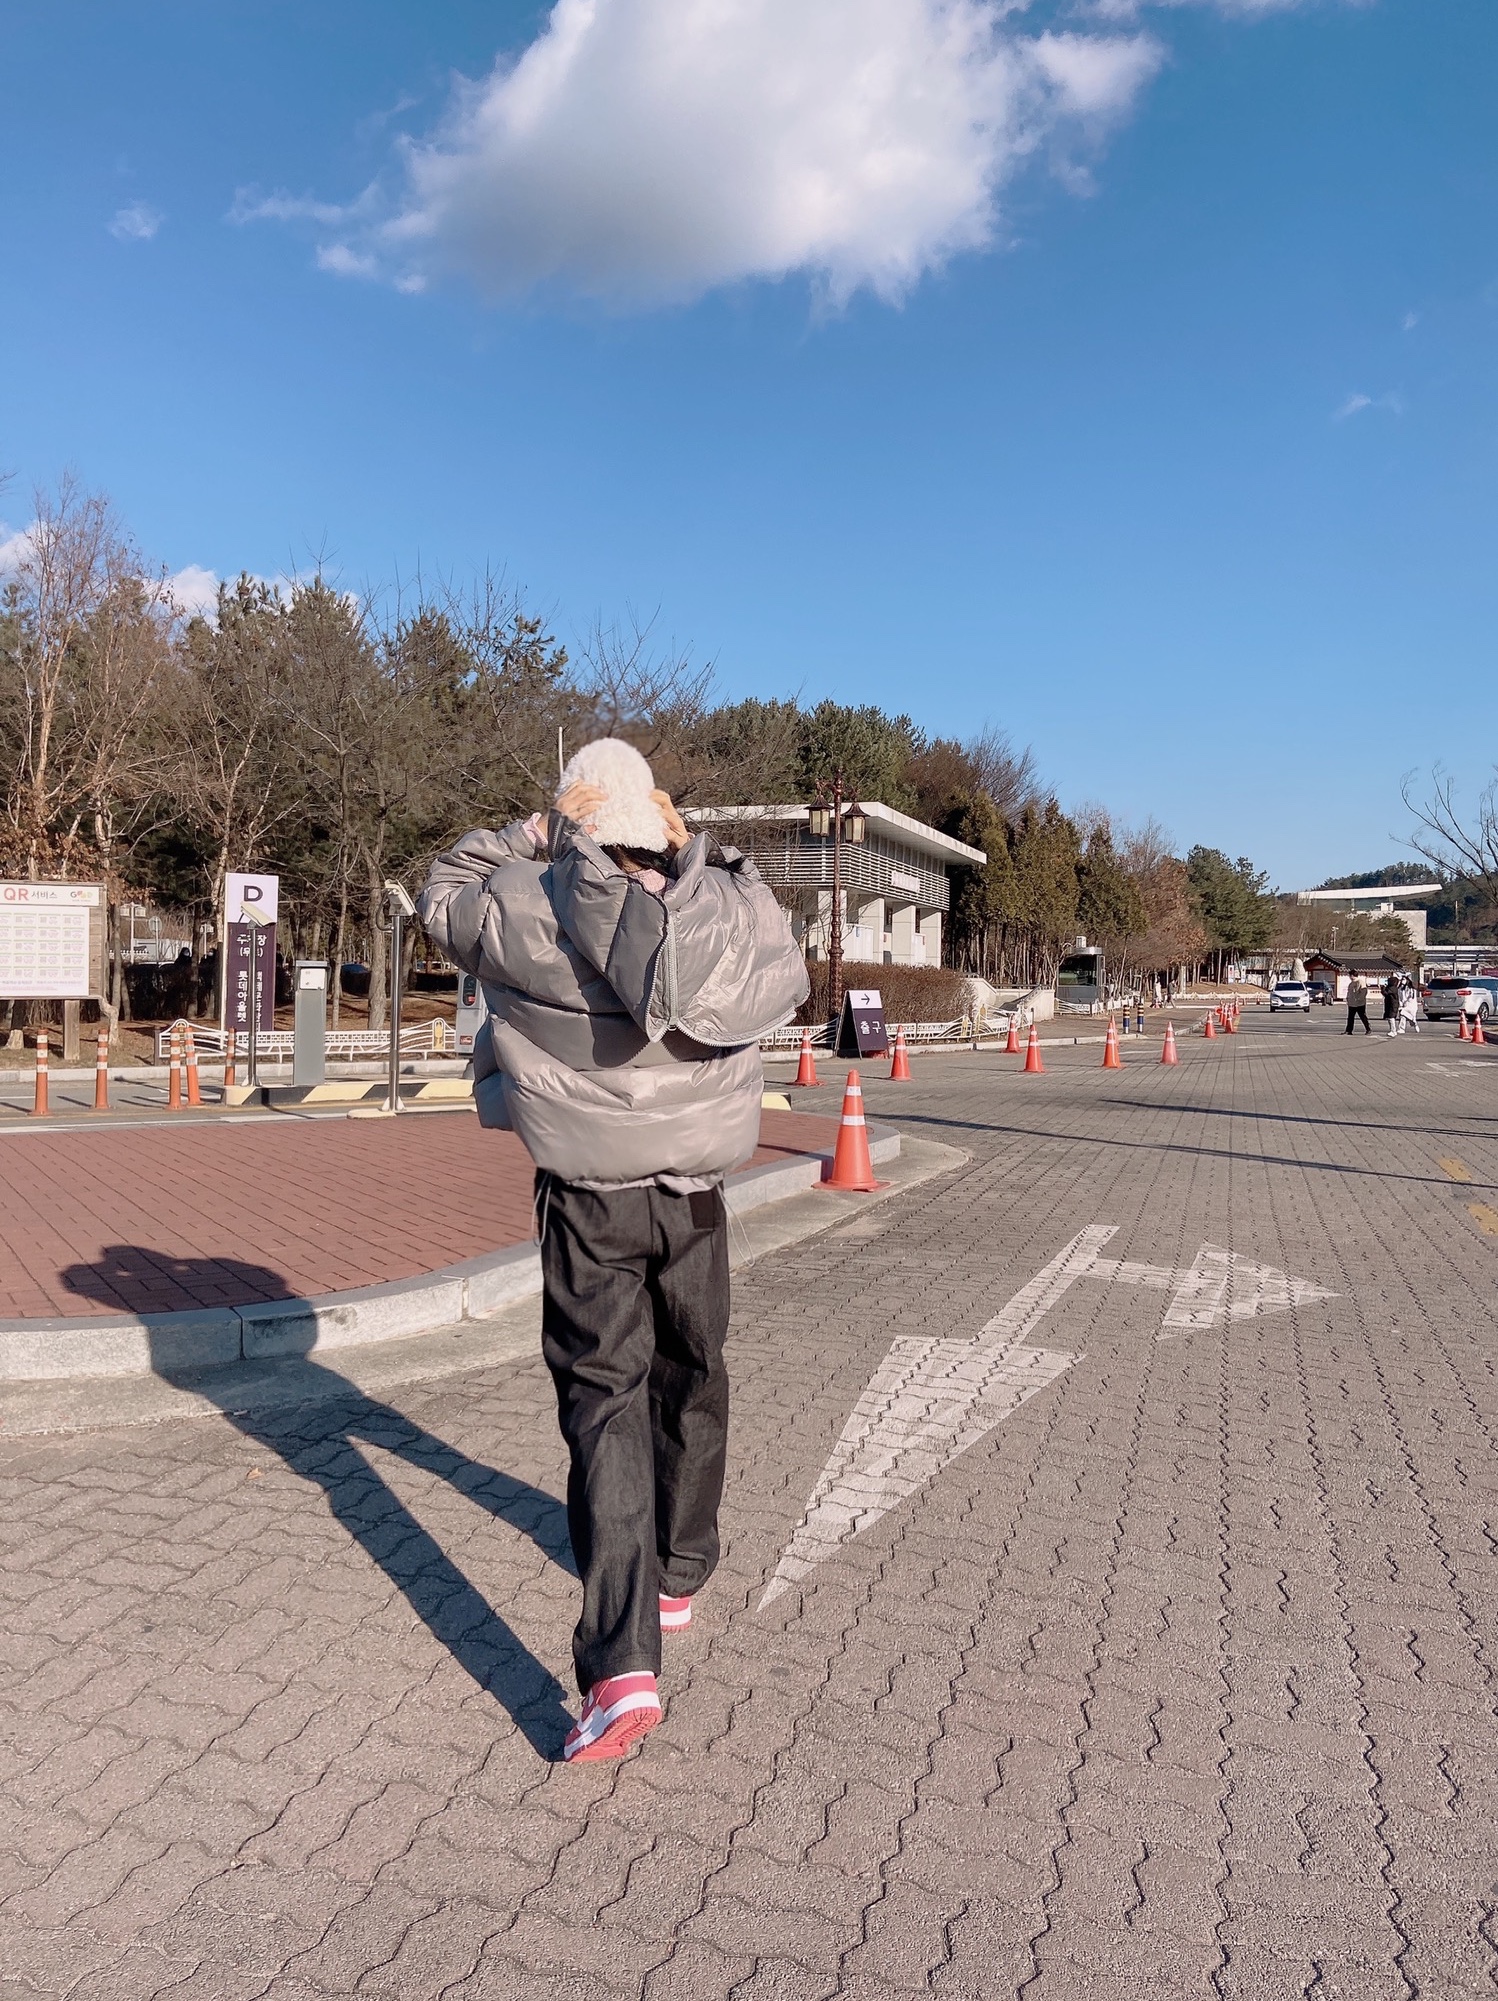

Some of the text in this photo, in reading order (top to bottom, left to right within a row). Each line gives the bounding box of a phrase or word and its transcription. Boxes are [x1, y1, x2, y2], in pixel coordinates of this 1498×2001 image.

[4, 887, 58, 901] QR 서비스
[243, 885, 264, 902] D
[237, 970, 249, 1023] 롯데아울렛
[860, 1020, 882, 1035] 출구
